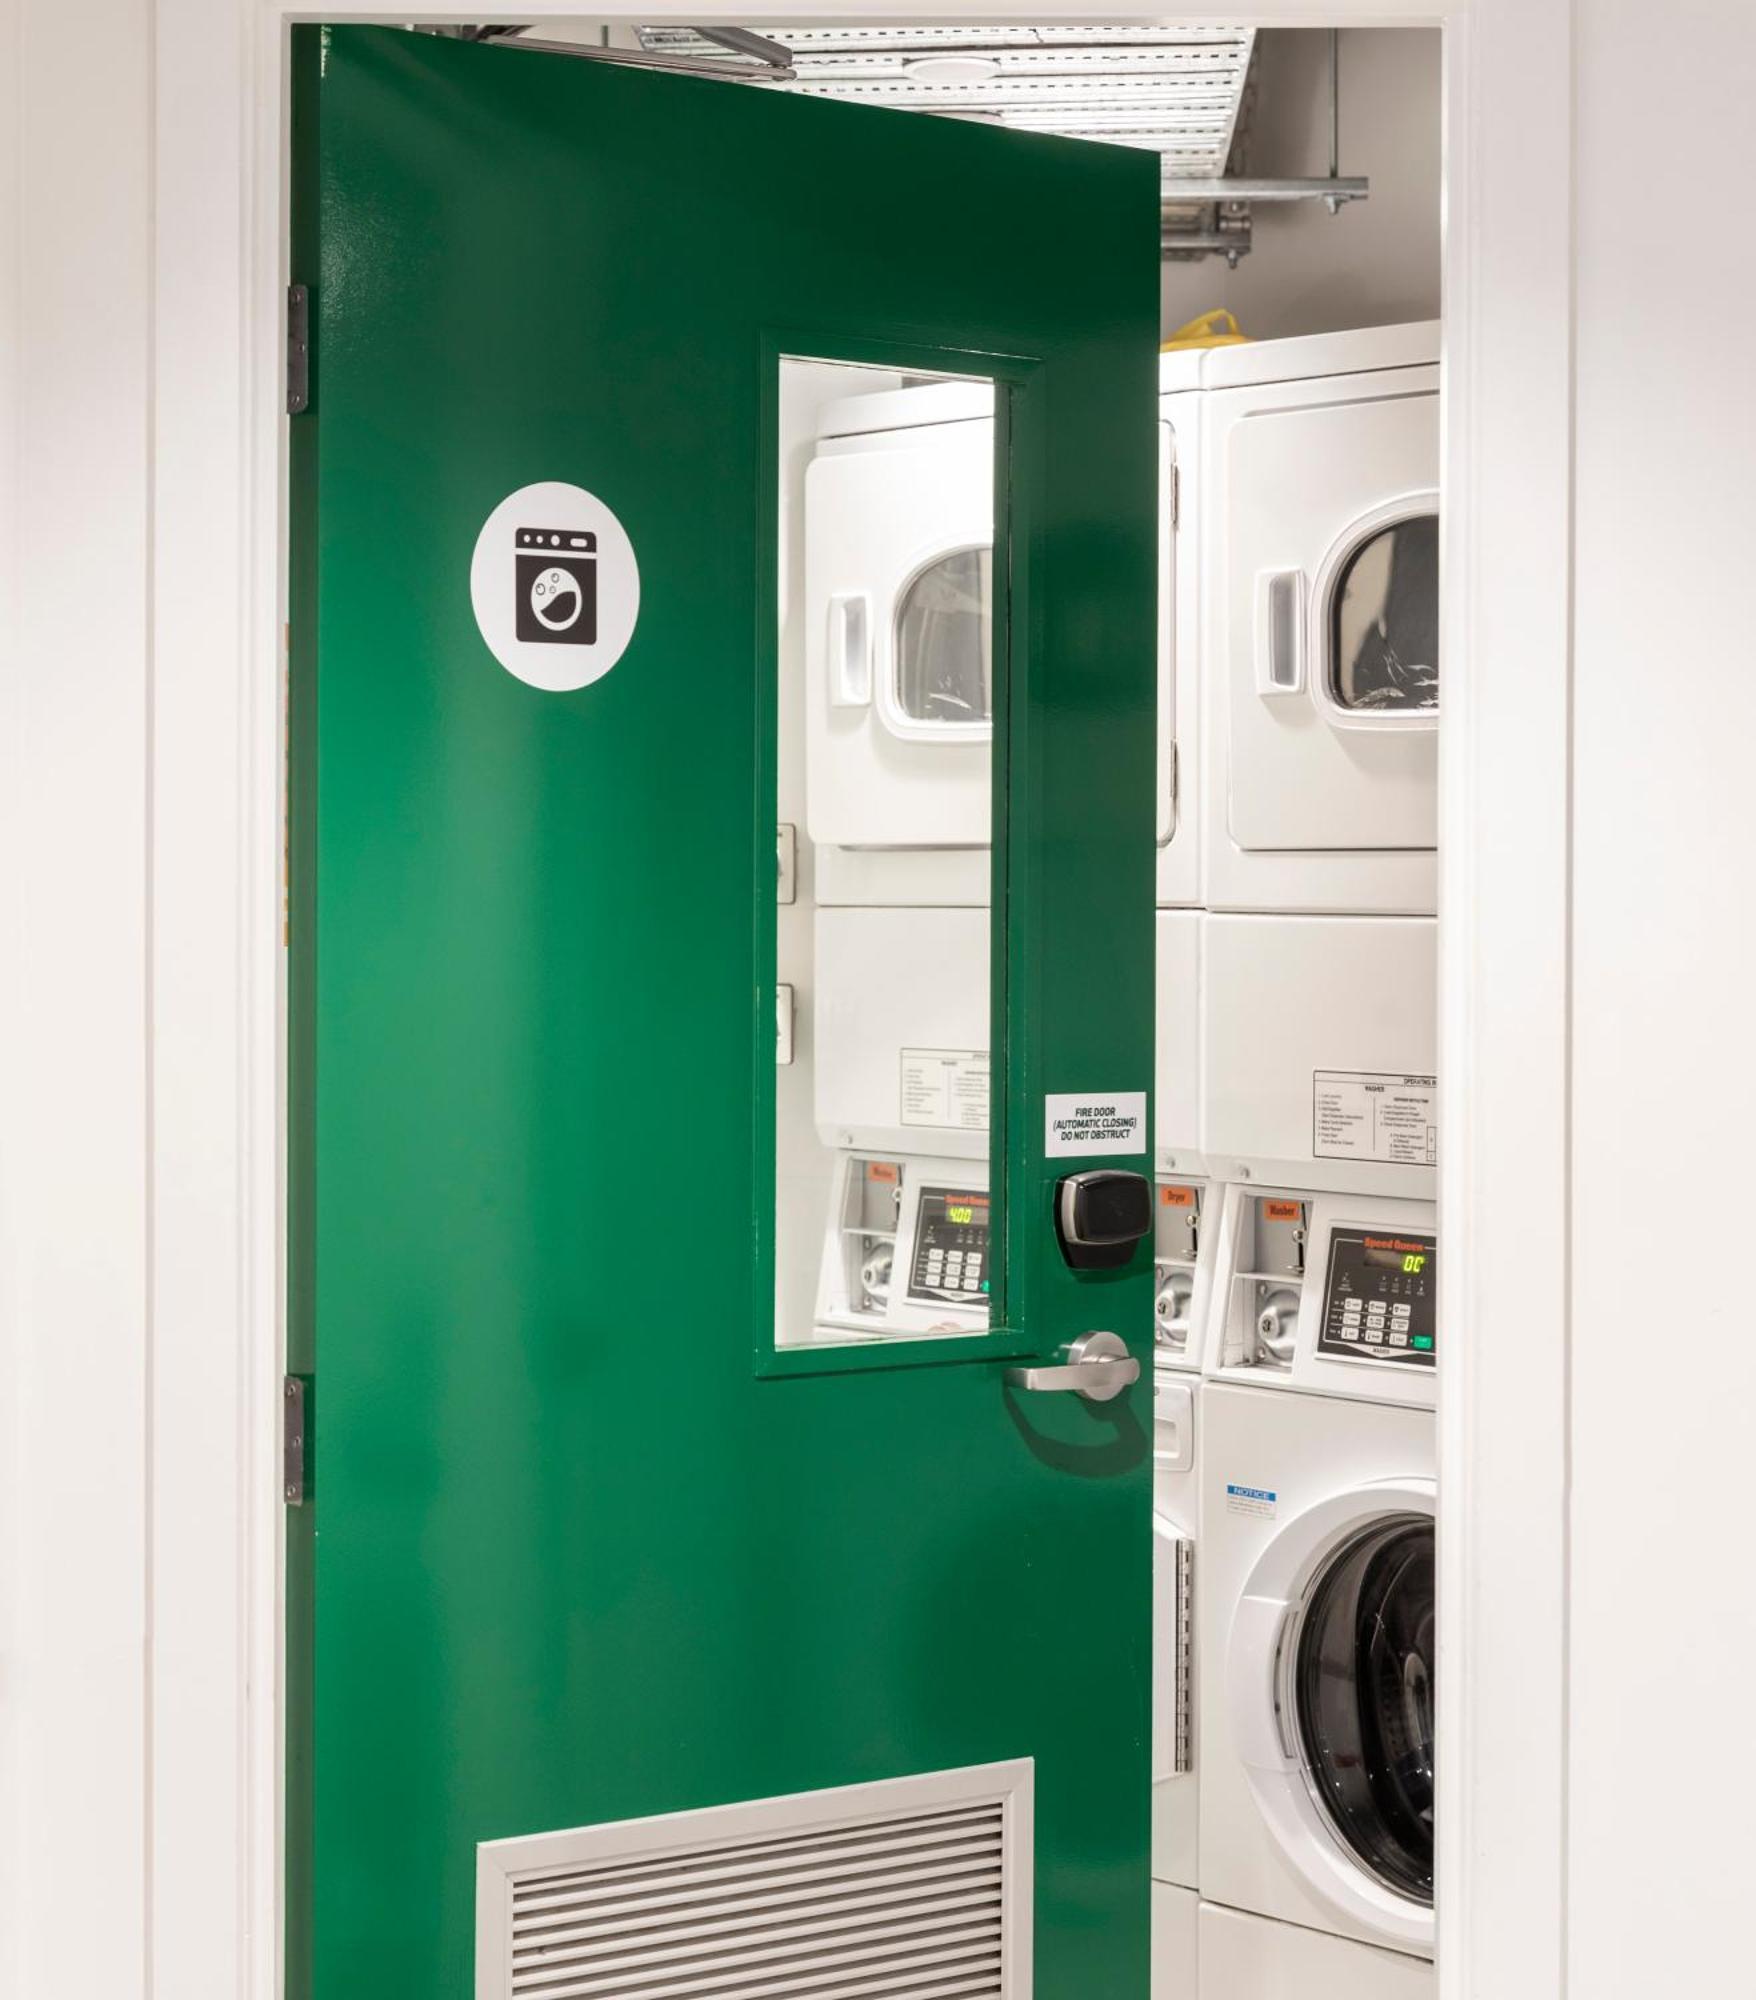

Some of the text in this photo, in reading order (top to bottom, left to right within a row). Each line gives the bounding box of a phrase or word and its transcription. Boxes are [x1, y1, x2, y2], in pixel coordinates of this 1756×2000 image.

[1075, 1107, 1116, 1117] FIRE DOOR
[1053, 1117, 1137, 1132] (AUTOMATIC CLOSING)
[1060, 1129, 1131, 1141] DO NOT OBSTRUCT
[1364, 1237, 1425, 1252] Speed Queen
[1233, 1487, 1269, 1499] NOTICE
